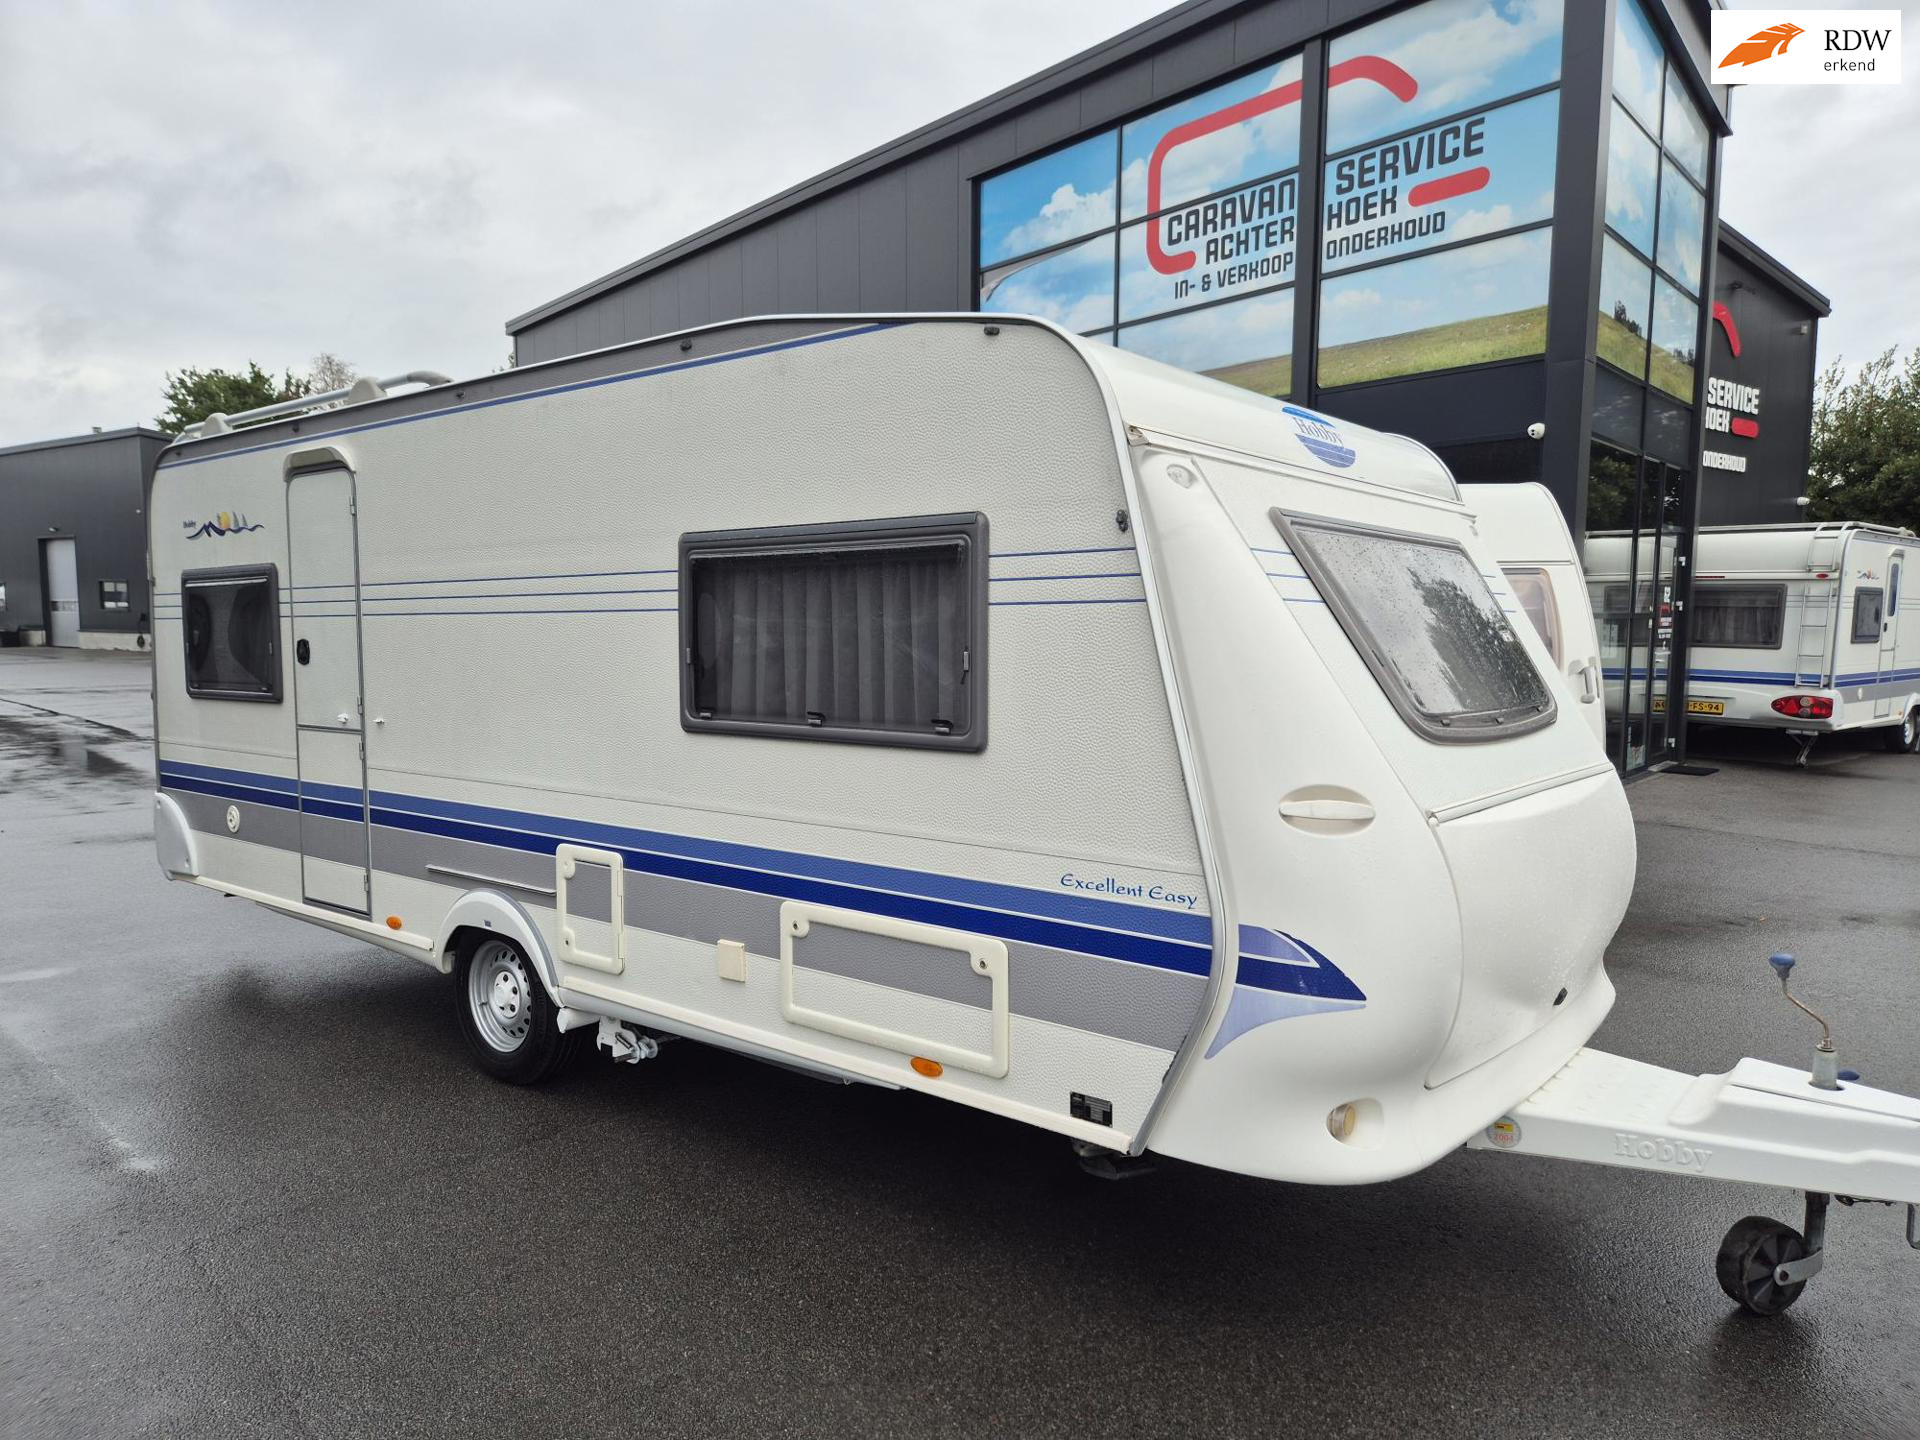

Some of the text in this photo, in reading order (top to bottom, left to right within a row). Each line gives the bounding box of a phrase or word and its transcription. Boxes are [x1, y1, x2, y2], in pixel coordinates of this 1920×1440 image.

[1167, 117, 1485, 246] CARAVAN SERVICE
[1205, 185, 1398, 265] ACHTER HOEK
[1174, 211, 1446, 300] IN- & VERKOOP ONDERHOUD
[1707, 377, 1760, 415] SERVICE
[1293, 416, 1344, 449] Hobby
[1702, 450, 1747, 473] ONDERHOUD
[1060, 873, 1198, 910] Excellent Easy
[1615, 1132, 1713, 1174] Hobby
